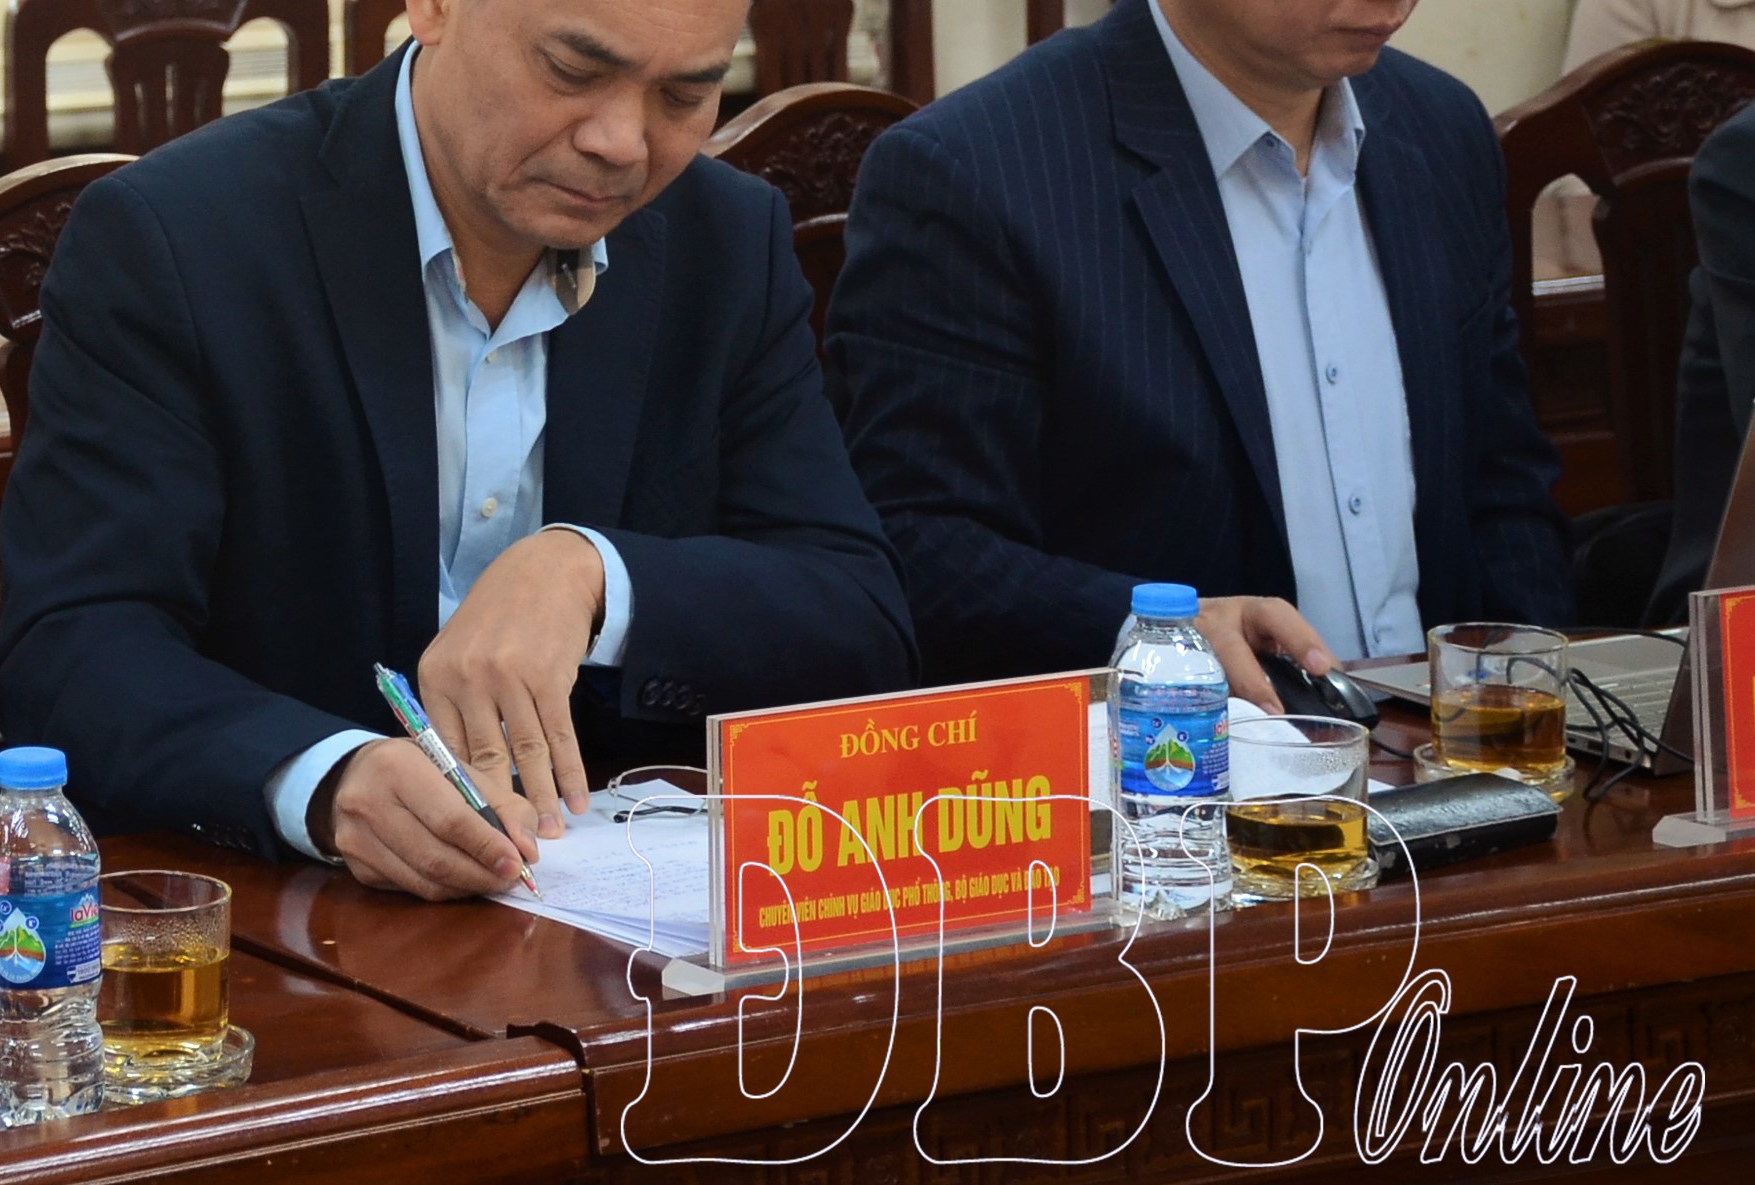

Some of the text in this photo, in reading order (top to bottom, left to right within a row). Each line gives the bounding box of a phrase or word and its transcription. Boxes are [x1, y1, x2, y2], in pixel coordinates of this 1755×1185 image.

[840, 710, 978, 759] ĐỒNG CHÍ
[766, 770, 1053, 877] ĐỖ ANH DŨNG
[759, 899, 794, 928] CHUYÊN
[795, 896, 816, 923] VIÊN
[818, 892, 846, 920] CHÍNH
[846, 894, 859, 920] VỤ
[860, 887, 882, 913] GIÁO
[902, 876, 921, 907] PHỔ
[955, 874, 968, 903] BỘ
[969, 872, 990, 898] GIÁO
[991, 872, 1010, 898] DỤC
[1010, 867, 1023, 892] VÀ
